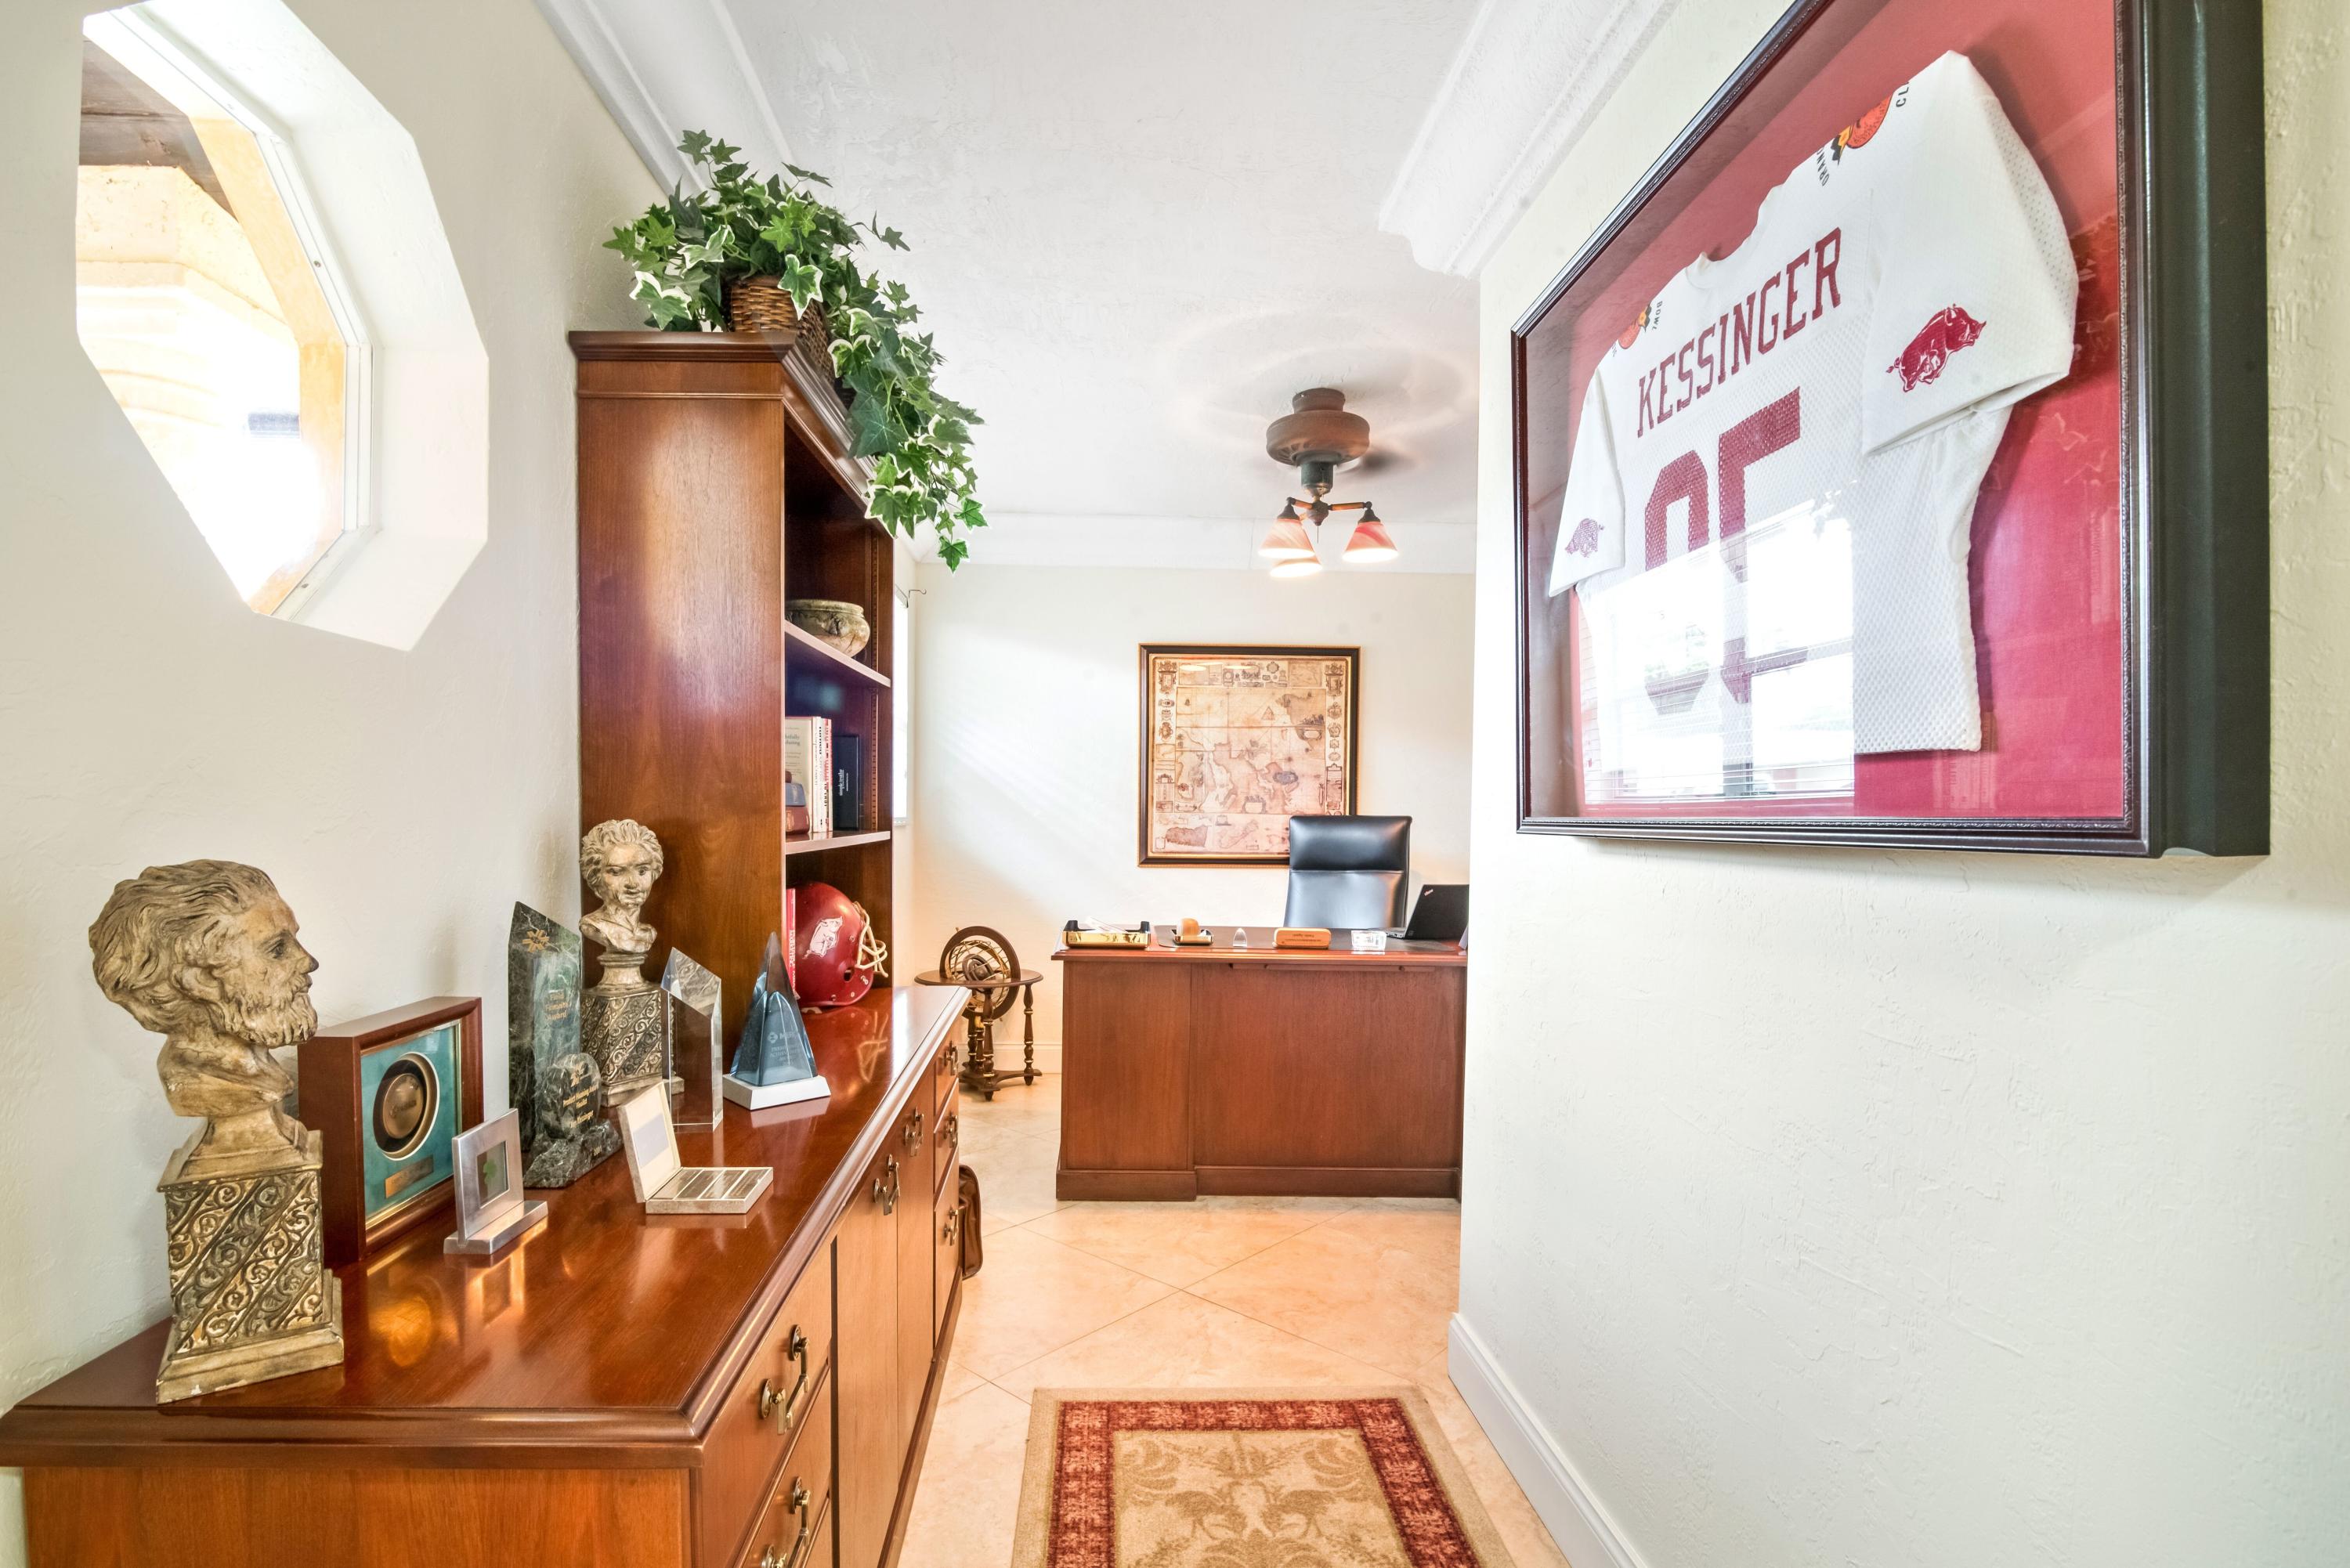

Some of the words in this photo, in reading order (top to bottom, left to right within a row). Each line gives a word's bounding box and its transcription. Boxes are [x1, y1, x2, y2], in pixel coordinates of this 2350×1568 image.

[1896, 81, 1910, 107] CL
[1652, 301, 1663, 331] BOWL
[1637, 226, 1842, 439] KESSINGER
